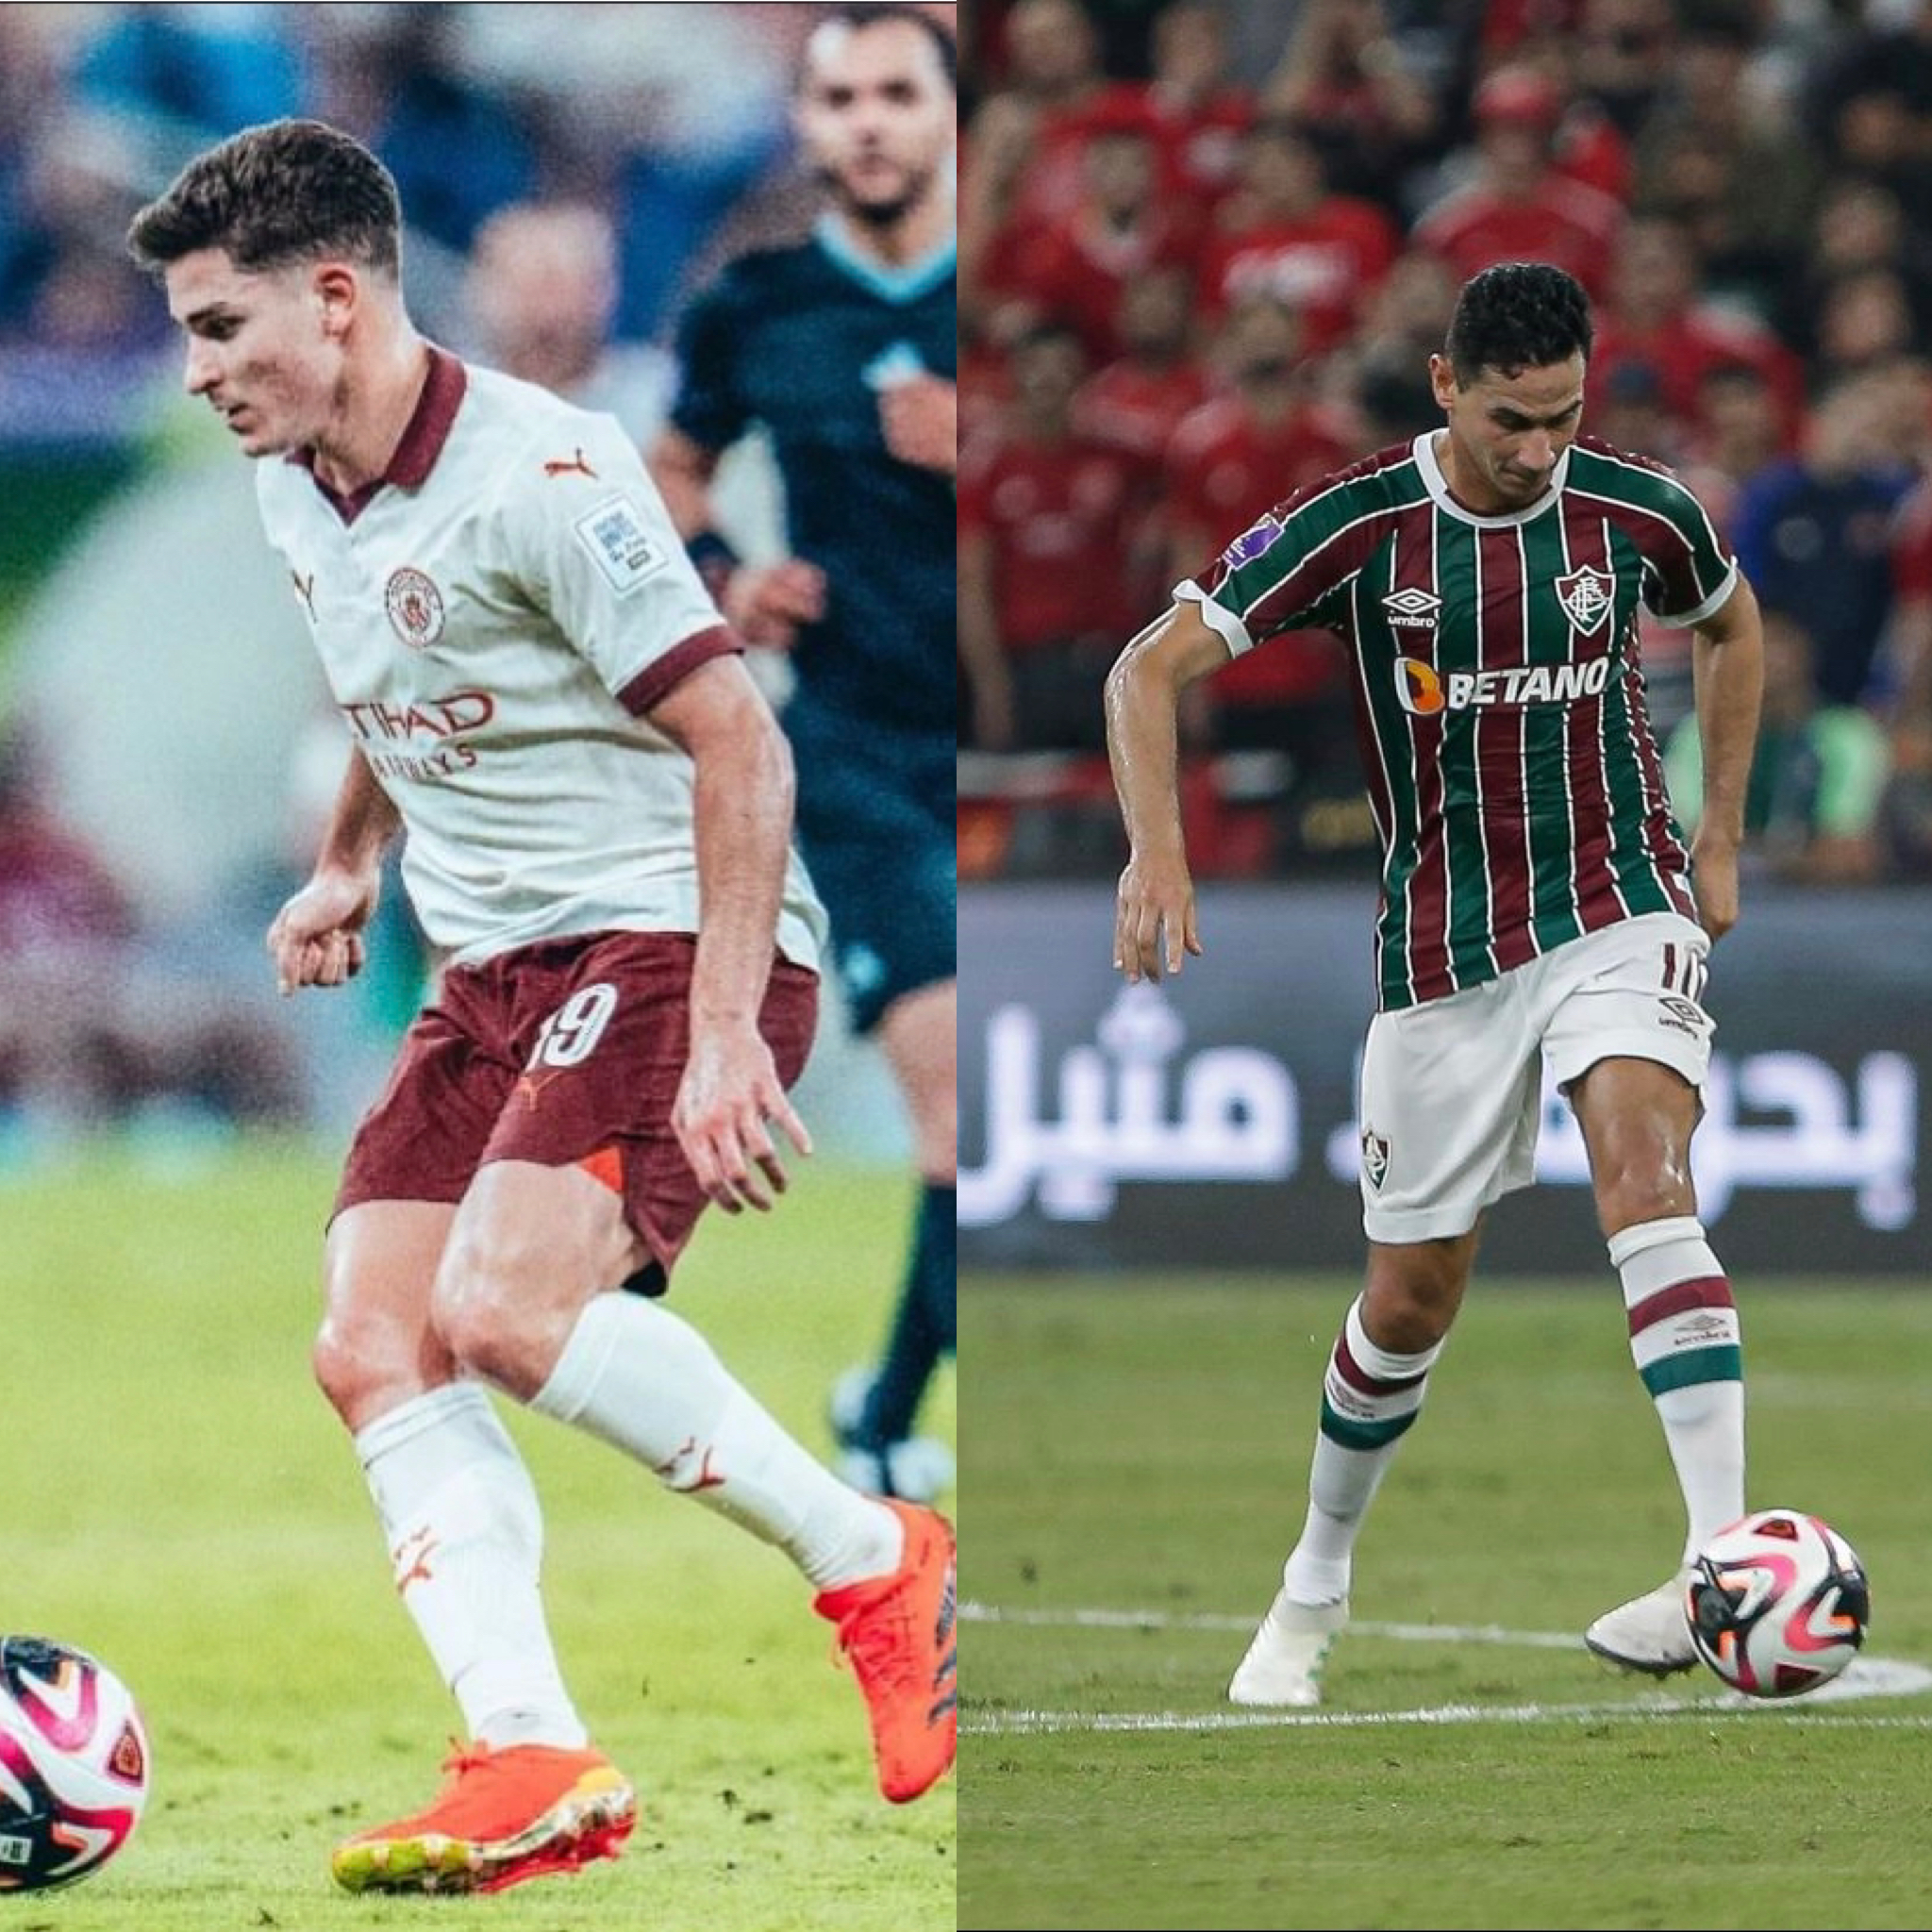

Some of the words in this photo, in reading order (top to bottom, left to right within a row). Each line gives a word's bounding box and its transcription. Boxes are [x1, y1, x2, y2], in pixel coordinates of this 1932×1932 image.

[1388, 616, 1435, 628] umbro
[1448, 657, 1609, 709] BETANO
[341, 692, 494, 740] TIHAD
[525, 982, 620, 1074] 19
